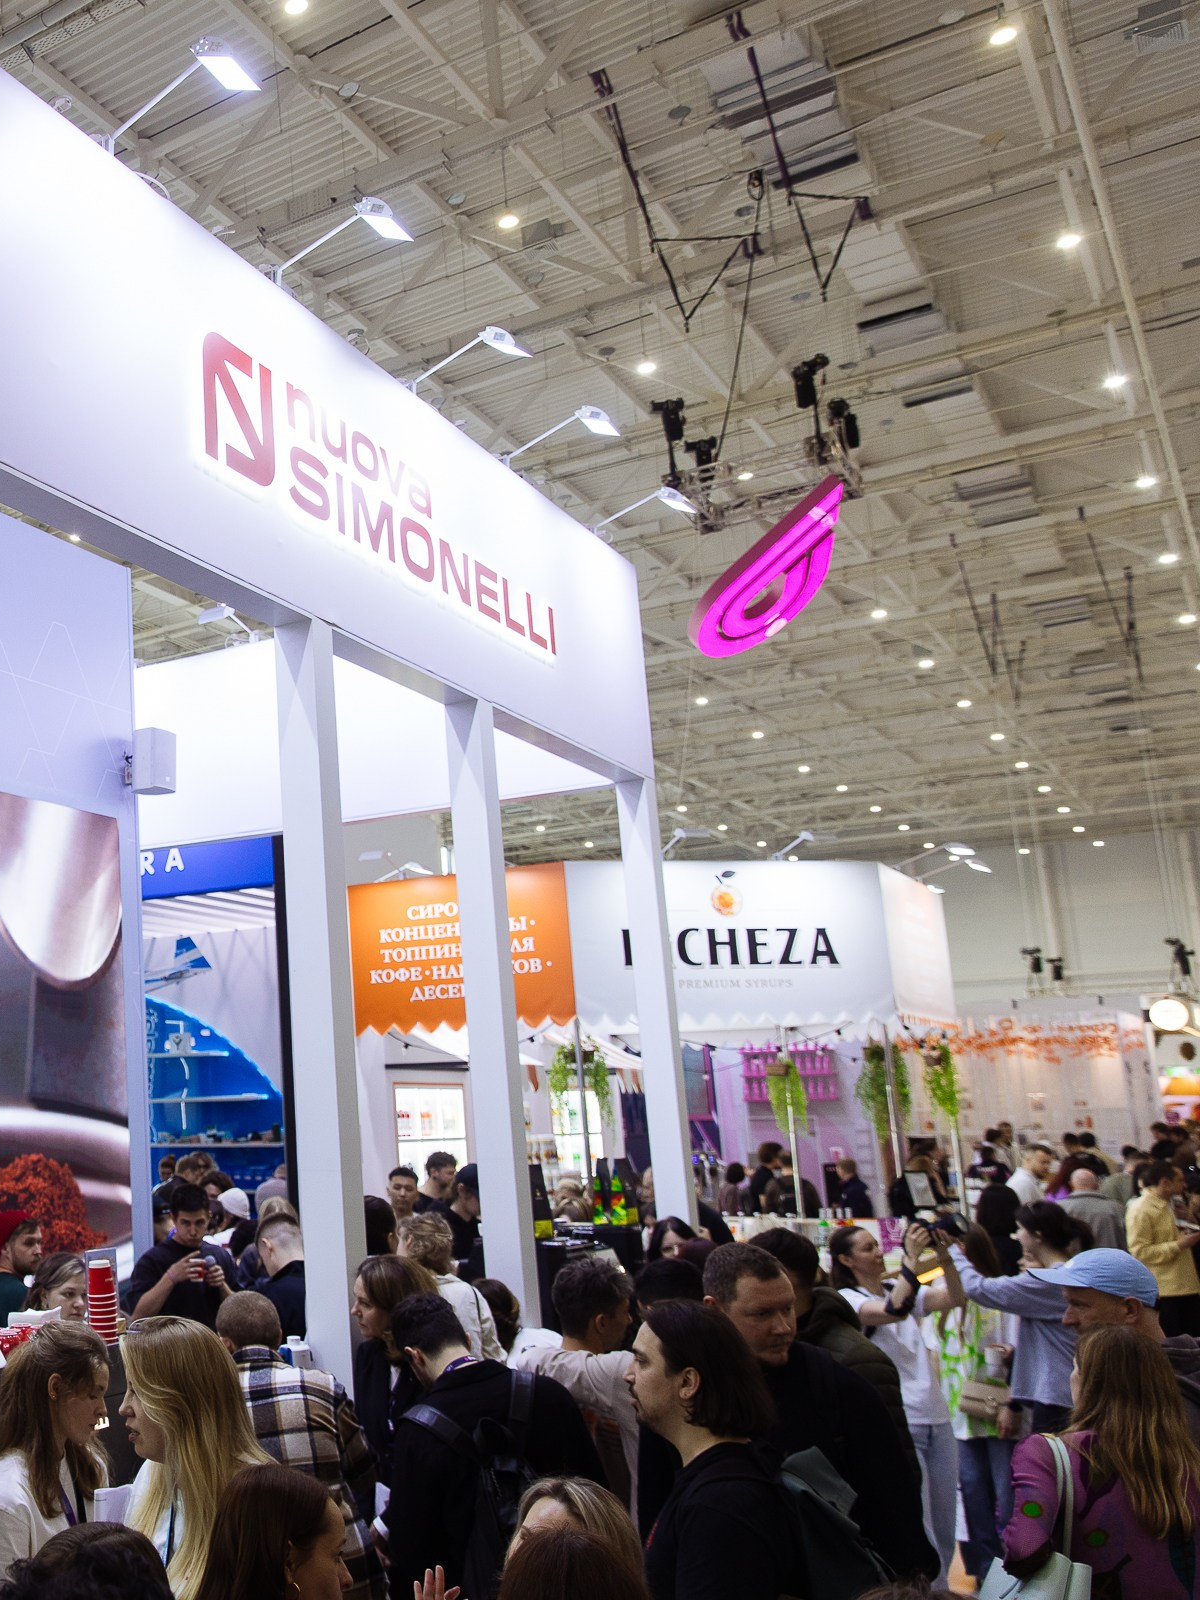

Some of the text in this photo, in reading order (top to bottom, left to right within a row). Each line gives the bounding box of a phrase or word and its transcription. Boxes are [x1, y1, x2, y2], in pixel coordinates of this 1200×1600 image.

[285, 380, 433, 520] nuova
[288, 445, 557, 656] SIMONELLI
[406, 901, 460, 921] СИРО
[380, 942, 463, 963] ТОППИН
[621, 927, 842, 967] CHEZA
[370, 966, 422, 984] КОФЕ
[678, 978, 793, 989] PREMIUM SYRUPS
[410, 983, 466, 1003] ДЕСЕ
